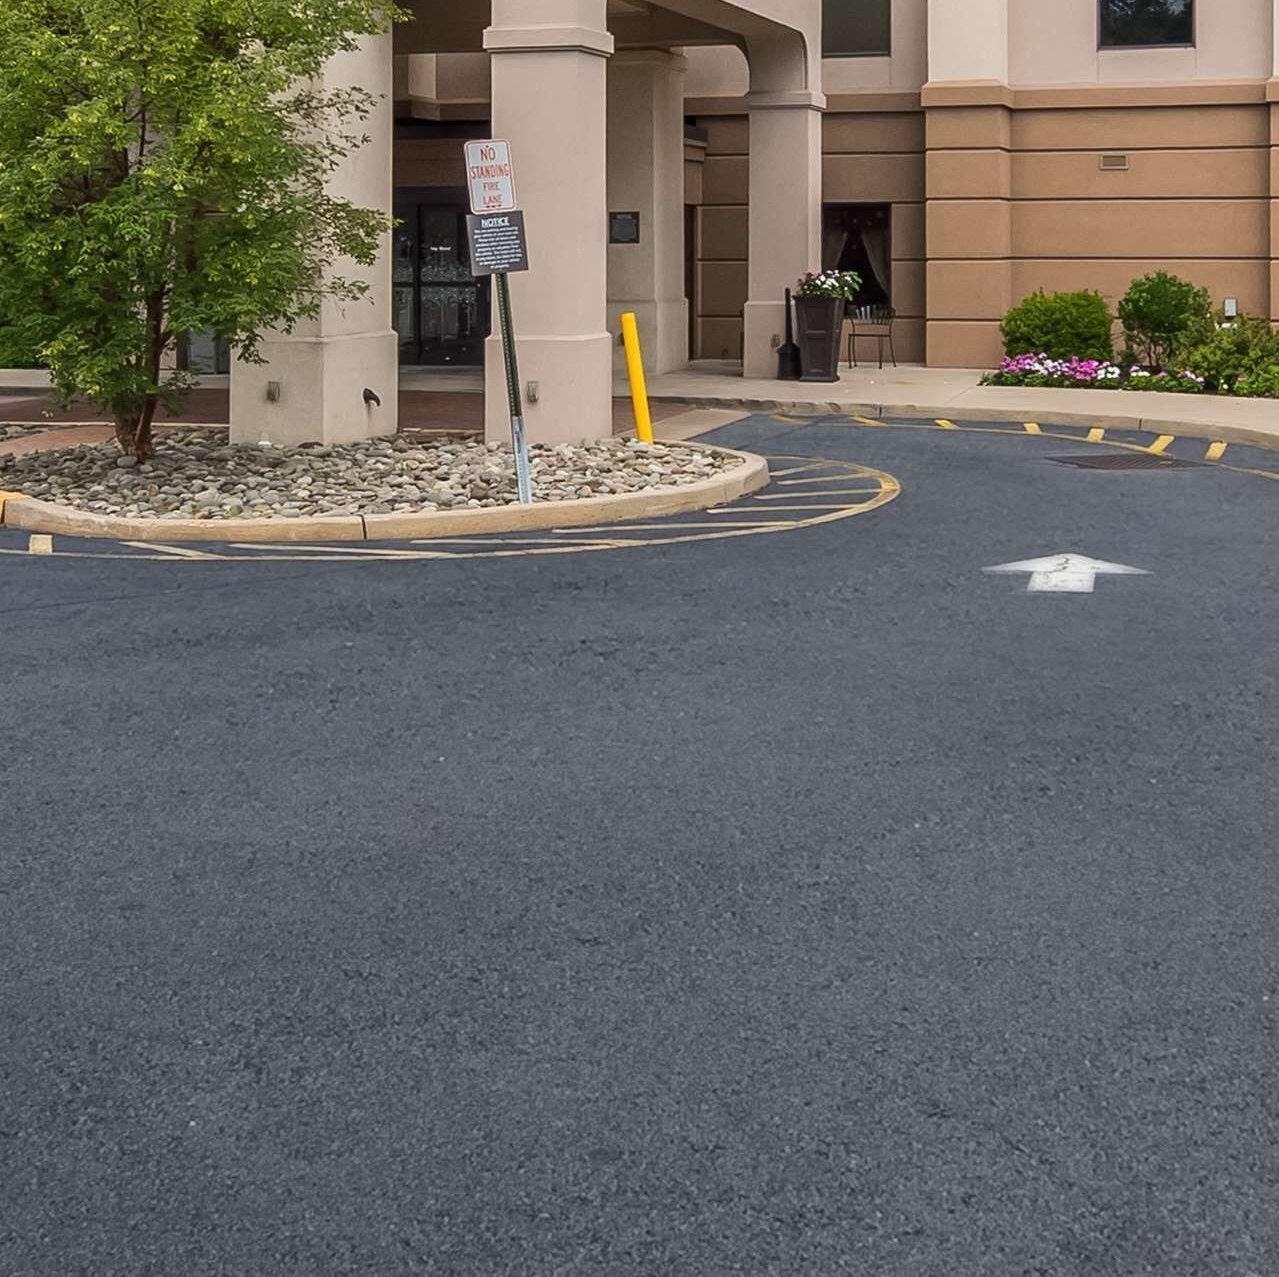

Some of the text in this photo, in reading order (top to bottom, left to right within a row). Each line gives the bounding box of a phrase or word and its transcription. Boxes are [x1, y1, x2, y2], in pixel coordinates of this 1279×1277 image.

[480, 147, 496, 161] NO
[471, 163, 510, 179] STANDING
[483, 181, 500, 191] FIRE
[483, 194, 502, 204] LANE
[481, 217, 509, 227] NOTICE
